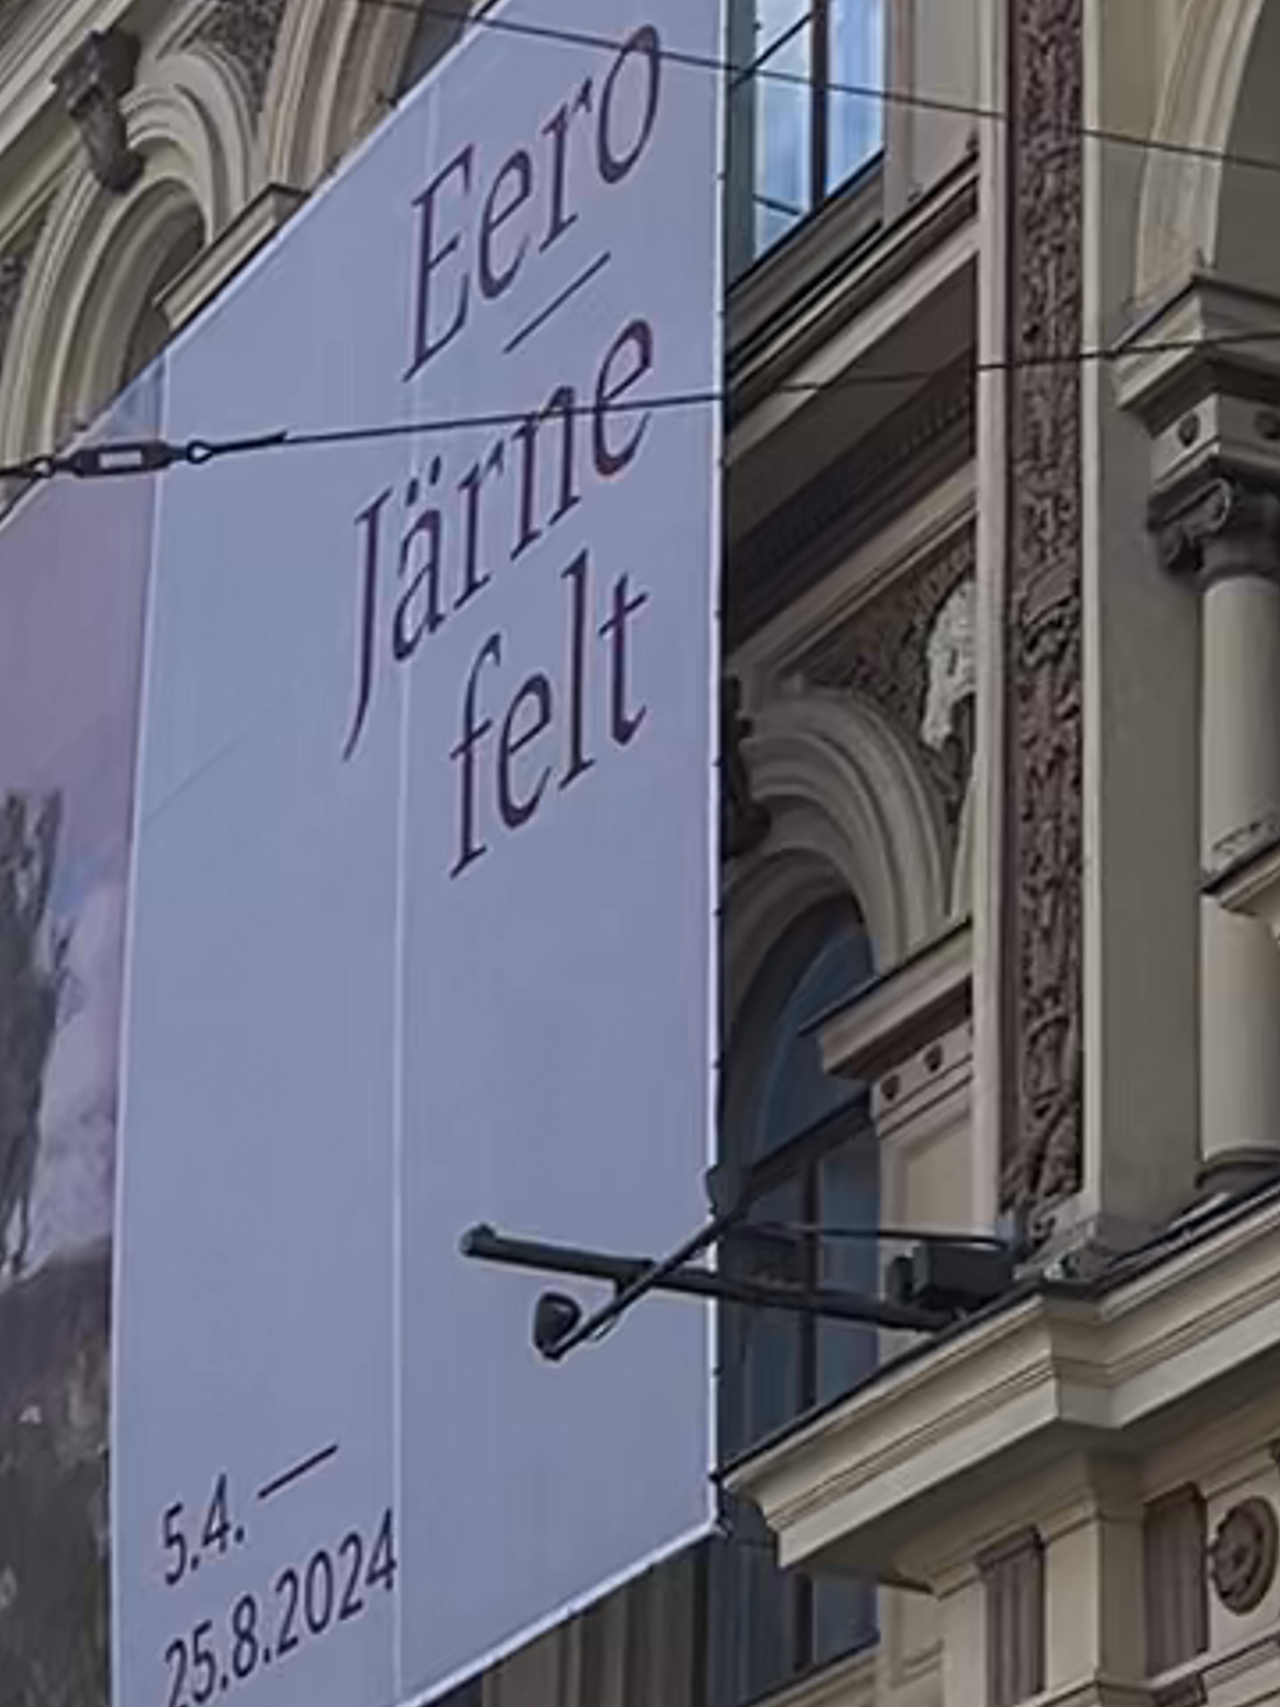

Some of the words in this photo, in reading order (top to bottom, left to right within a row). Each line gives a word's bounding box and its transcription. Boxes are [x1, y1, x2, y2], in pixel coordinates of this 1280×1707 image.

[403, 23, 661, 383] Eero
[341, 318, 653, 762] Järne
[447, 548, 649, 879] felt
